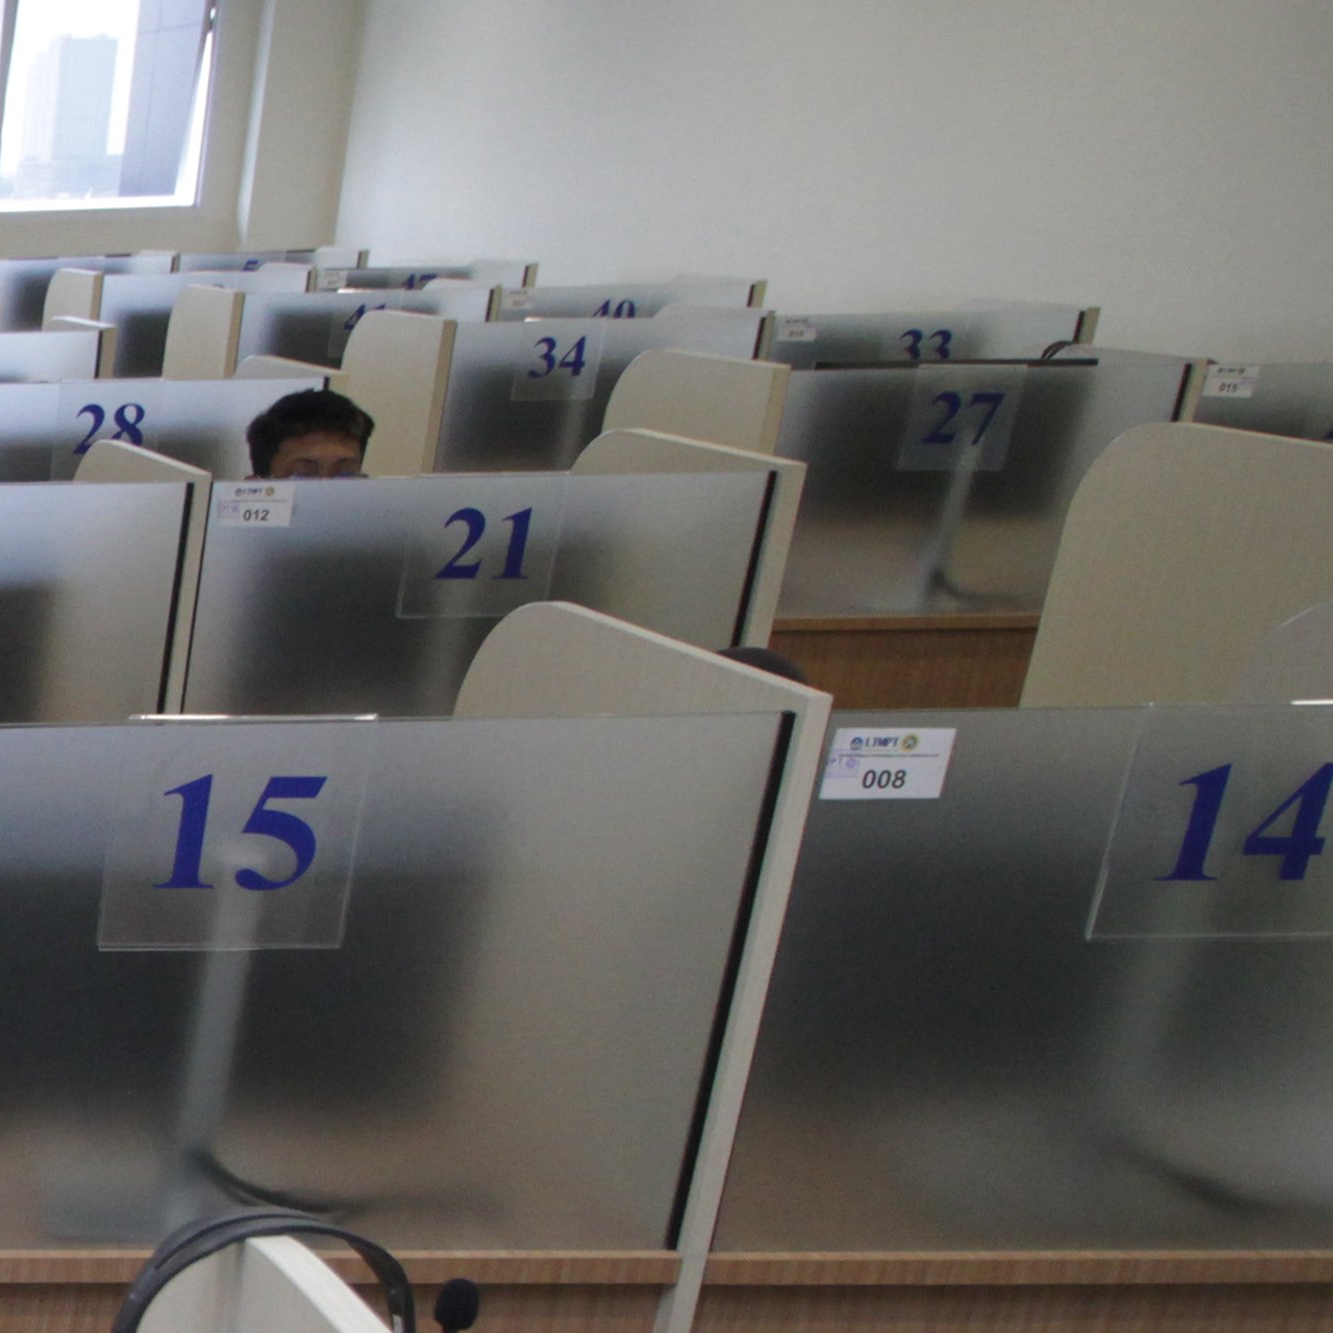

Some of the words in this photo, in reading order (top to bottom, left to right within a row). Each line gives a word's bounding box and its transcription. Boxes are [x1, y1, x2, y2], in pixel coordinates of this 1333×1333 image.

[528, 336, 587, 379] 34
[72, 403, 147, 454] 28
[922, 391, 1006, 446] 27
[243, 508, 270, 521] 012
[434, 508, 533, 579] 21
[862, 769, 907, 789] 008
[153, 773, 328, 891] 15
[1153, 762, 1333, 881] 14
